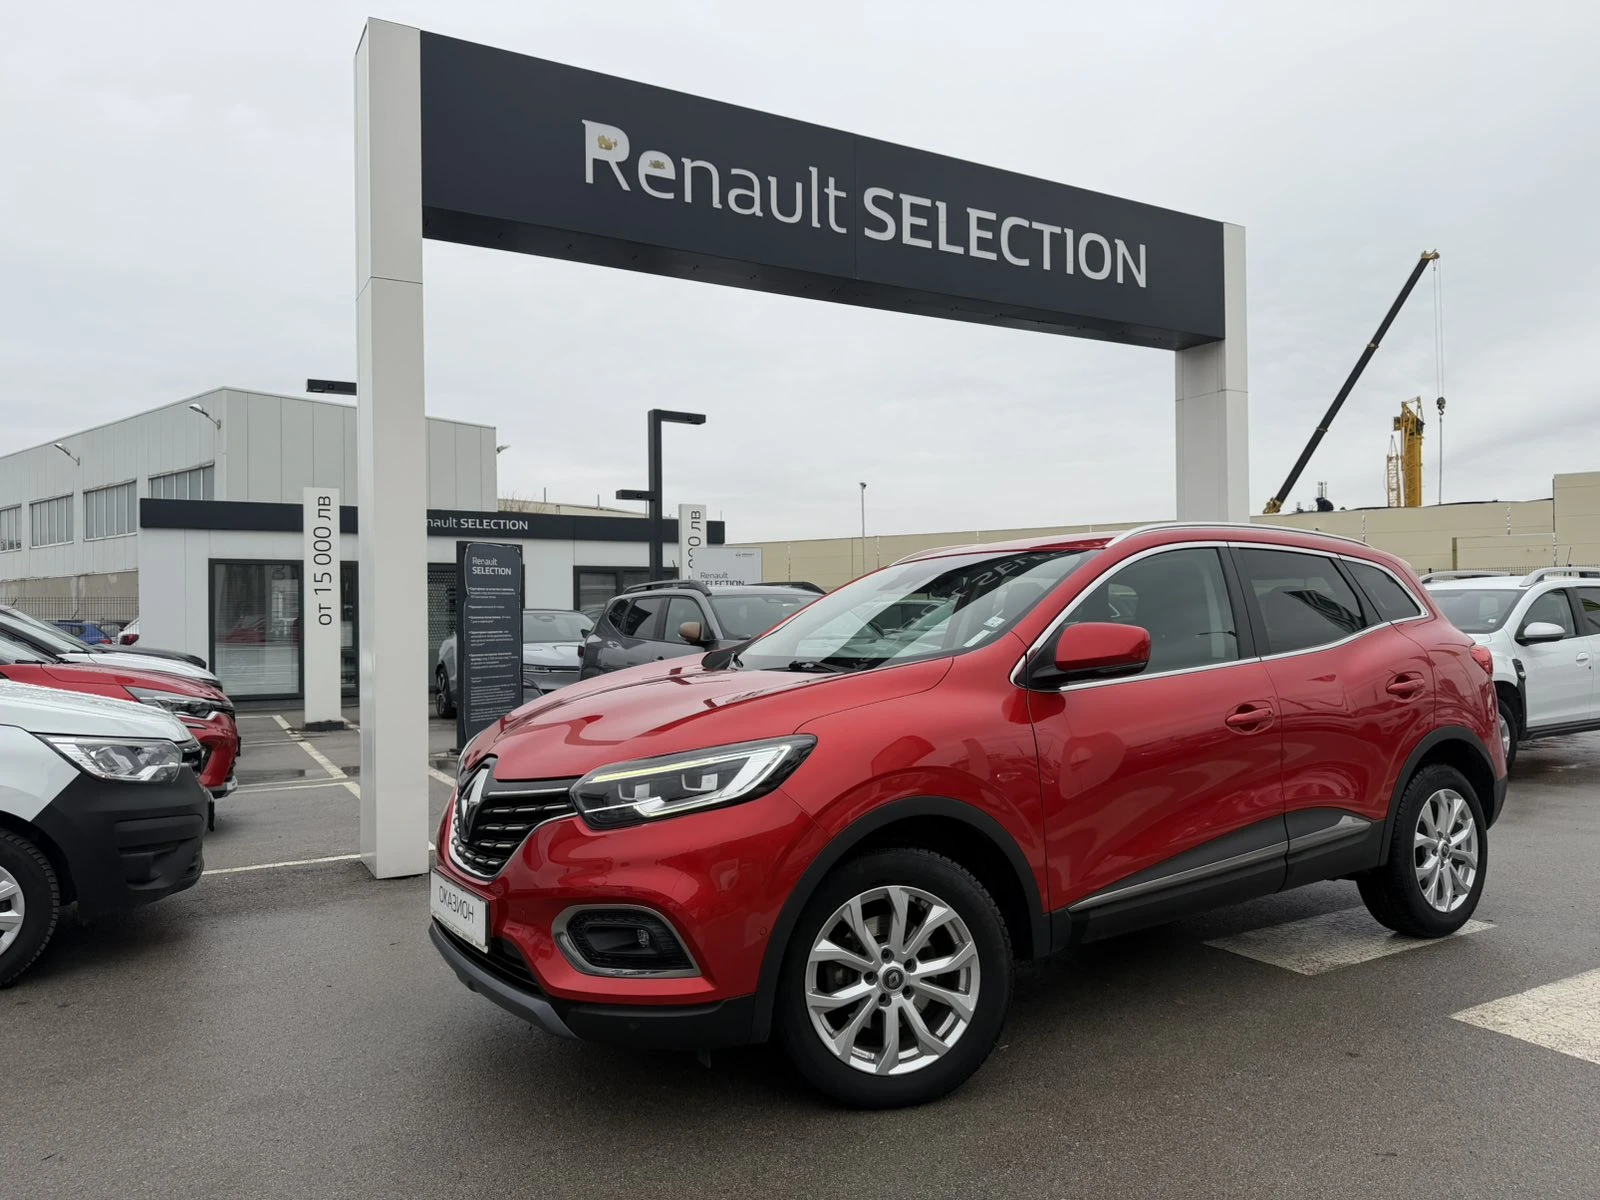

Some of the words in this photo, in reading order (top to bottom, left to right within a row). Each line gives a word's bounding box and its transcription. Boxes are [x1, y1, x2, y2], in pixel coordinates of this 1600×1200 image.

[581, 119, 847, 234] Renault
[863, 187, 1147, 288] SELECTION
[427, 517, 458, 528] nault
[460, 518, 528, 530] SELECTION
[313, 526, 332, 565] 000
[472, 556, 498, 566] Renault
[472, 566, 512, 576] SELECTION
[313, 572, 332, 595] 15
[439, 886, 474, 924] ОКАЗИОН
